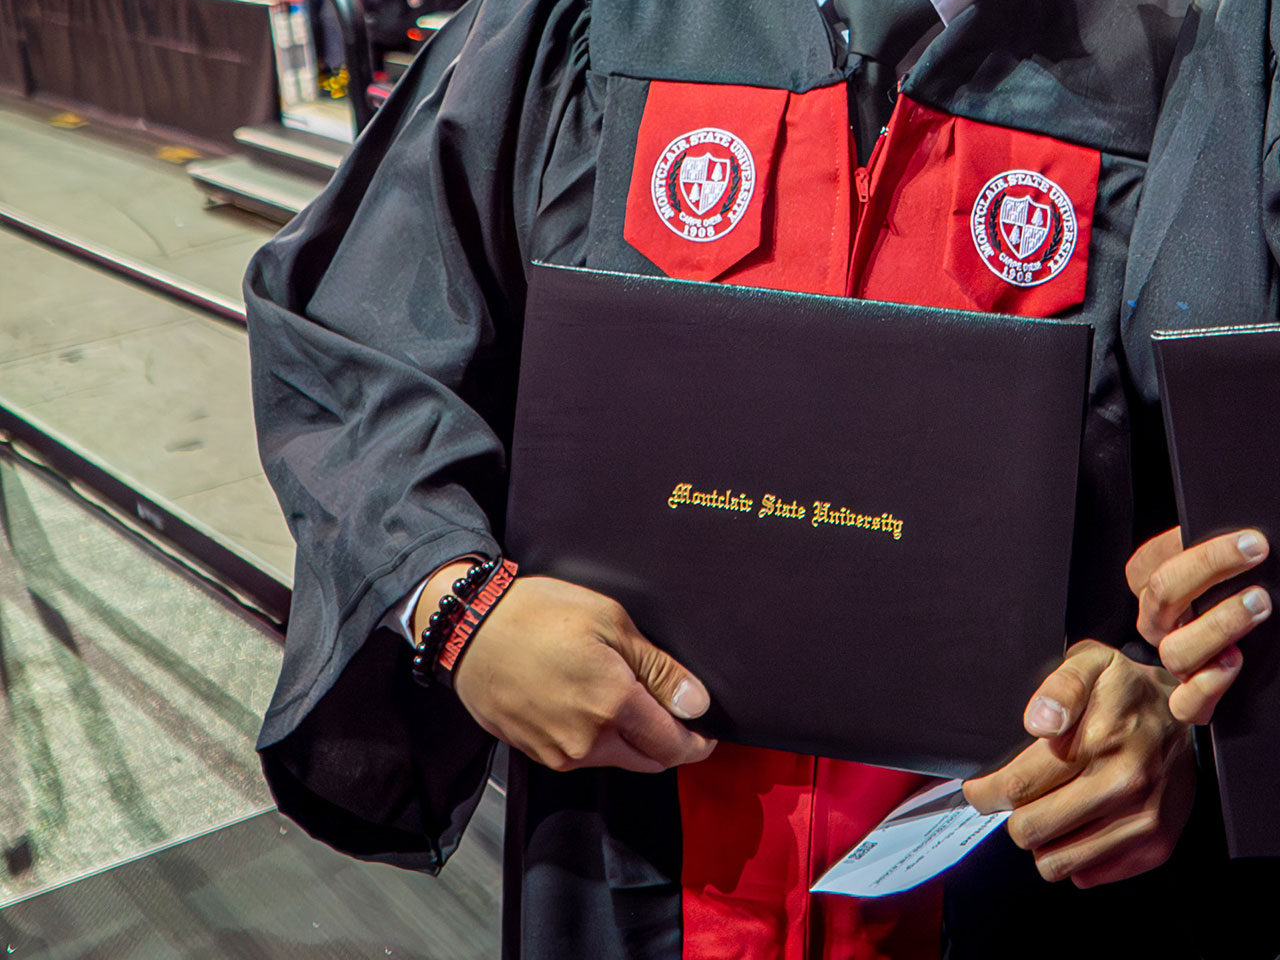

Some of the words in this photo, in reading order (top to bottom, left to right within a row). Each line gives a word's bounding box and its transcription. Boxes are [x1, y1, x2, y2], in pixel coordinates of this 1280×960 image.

[656, 140, 689, 220] MONTCLAIR
[689, 132, 731, 147] STATE
[727, 141, 752, 223] UNIVERSITY
[682, 225, 715, 237] 1908
[975, 179, 1008, 258] MONTCLAIR
[1007, 174, 1049, 193] STATE
[1048, 188, 1074, 273] UNIVERSITY
[1002, 266, 1032, 282] 1908
[667, 482, 754, 513] Montclair
[758, 493, 807, 519] State
[811, 500, 904, 540] University
[440, 610, 479, 671] VARSITY
[470, 567, 514, 616] HOUSE
